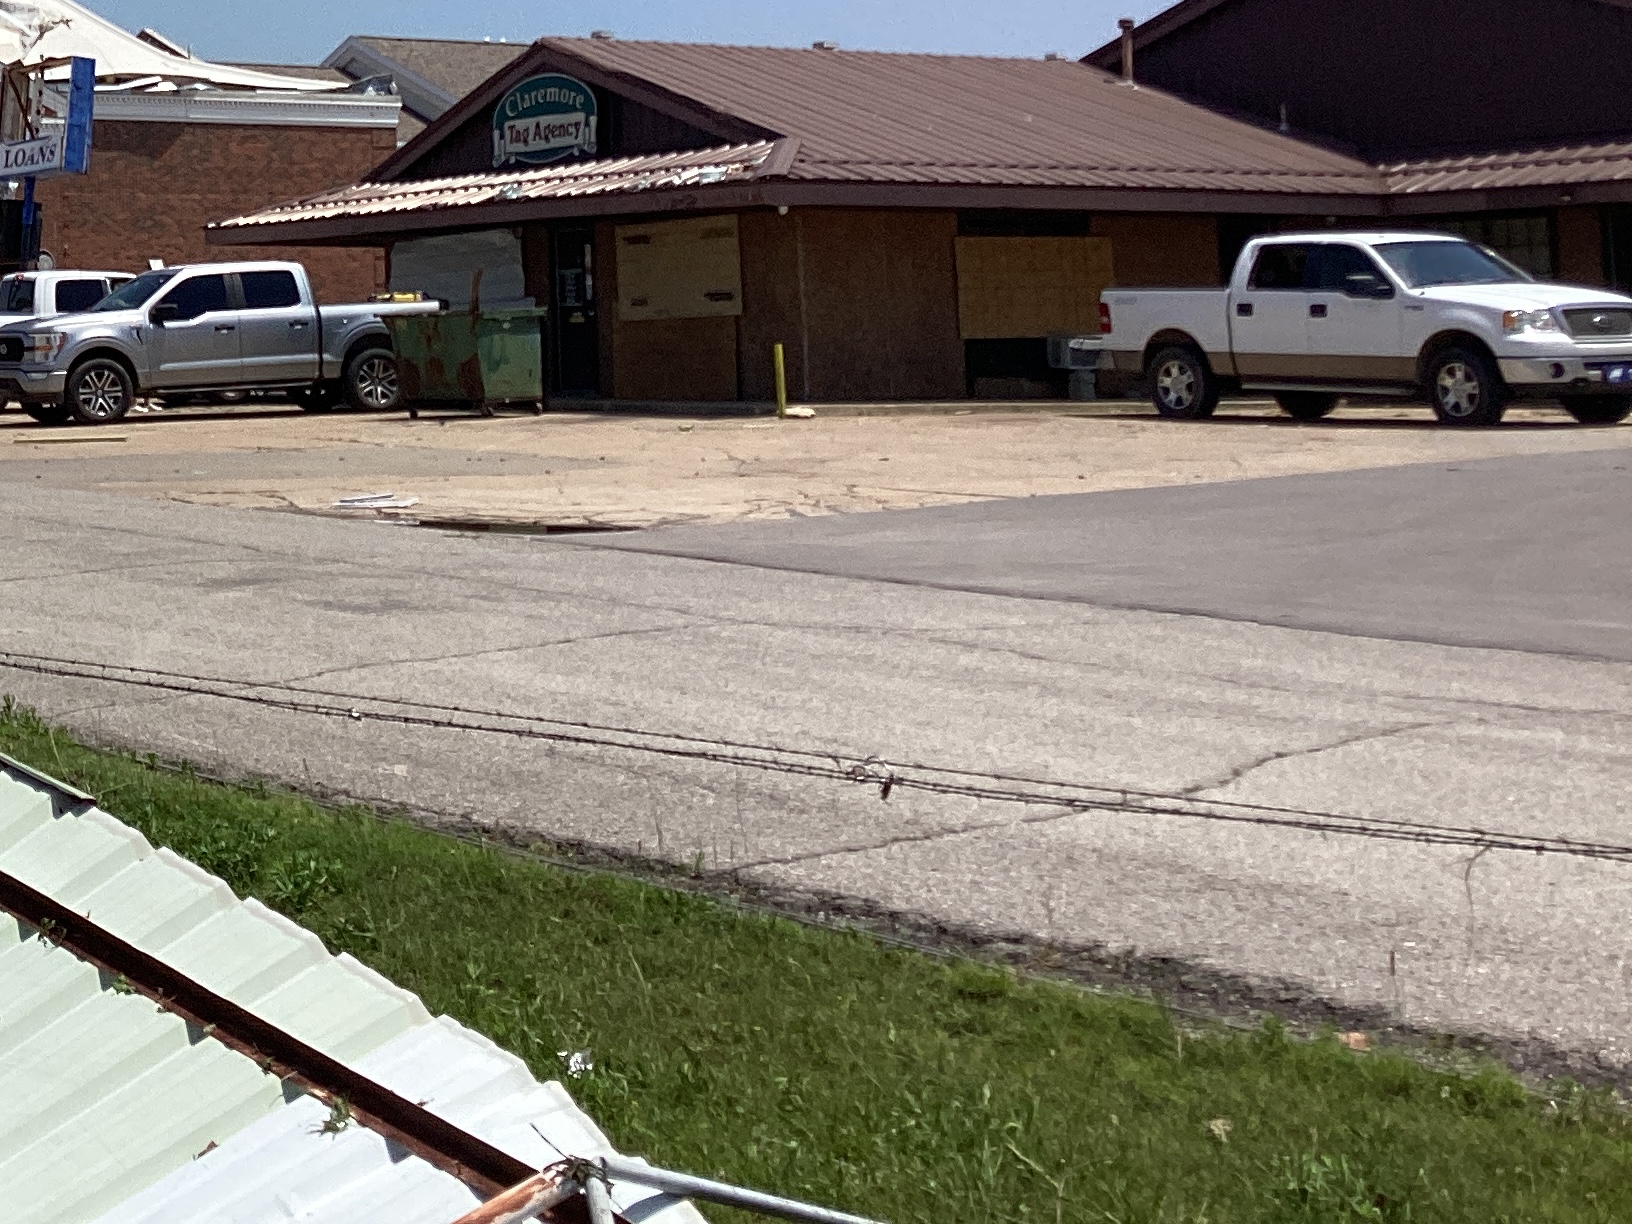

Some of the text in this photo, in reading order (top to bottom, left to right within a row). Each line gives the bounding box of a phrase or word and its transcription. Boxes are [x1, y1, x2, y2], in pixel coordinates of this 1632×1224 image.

[505, 87, 585, 117] Claremore
[507, 120, 582, 147] Tag Agency
[3, 143, 57, 169] LOANS
